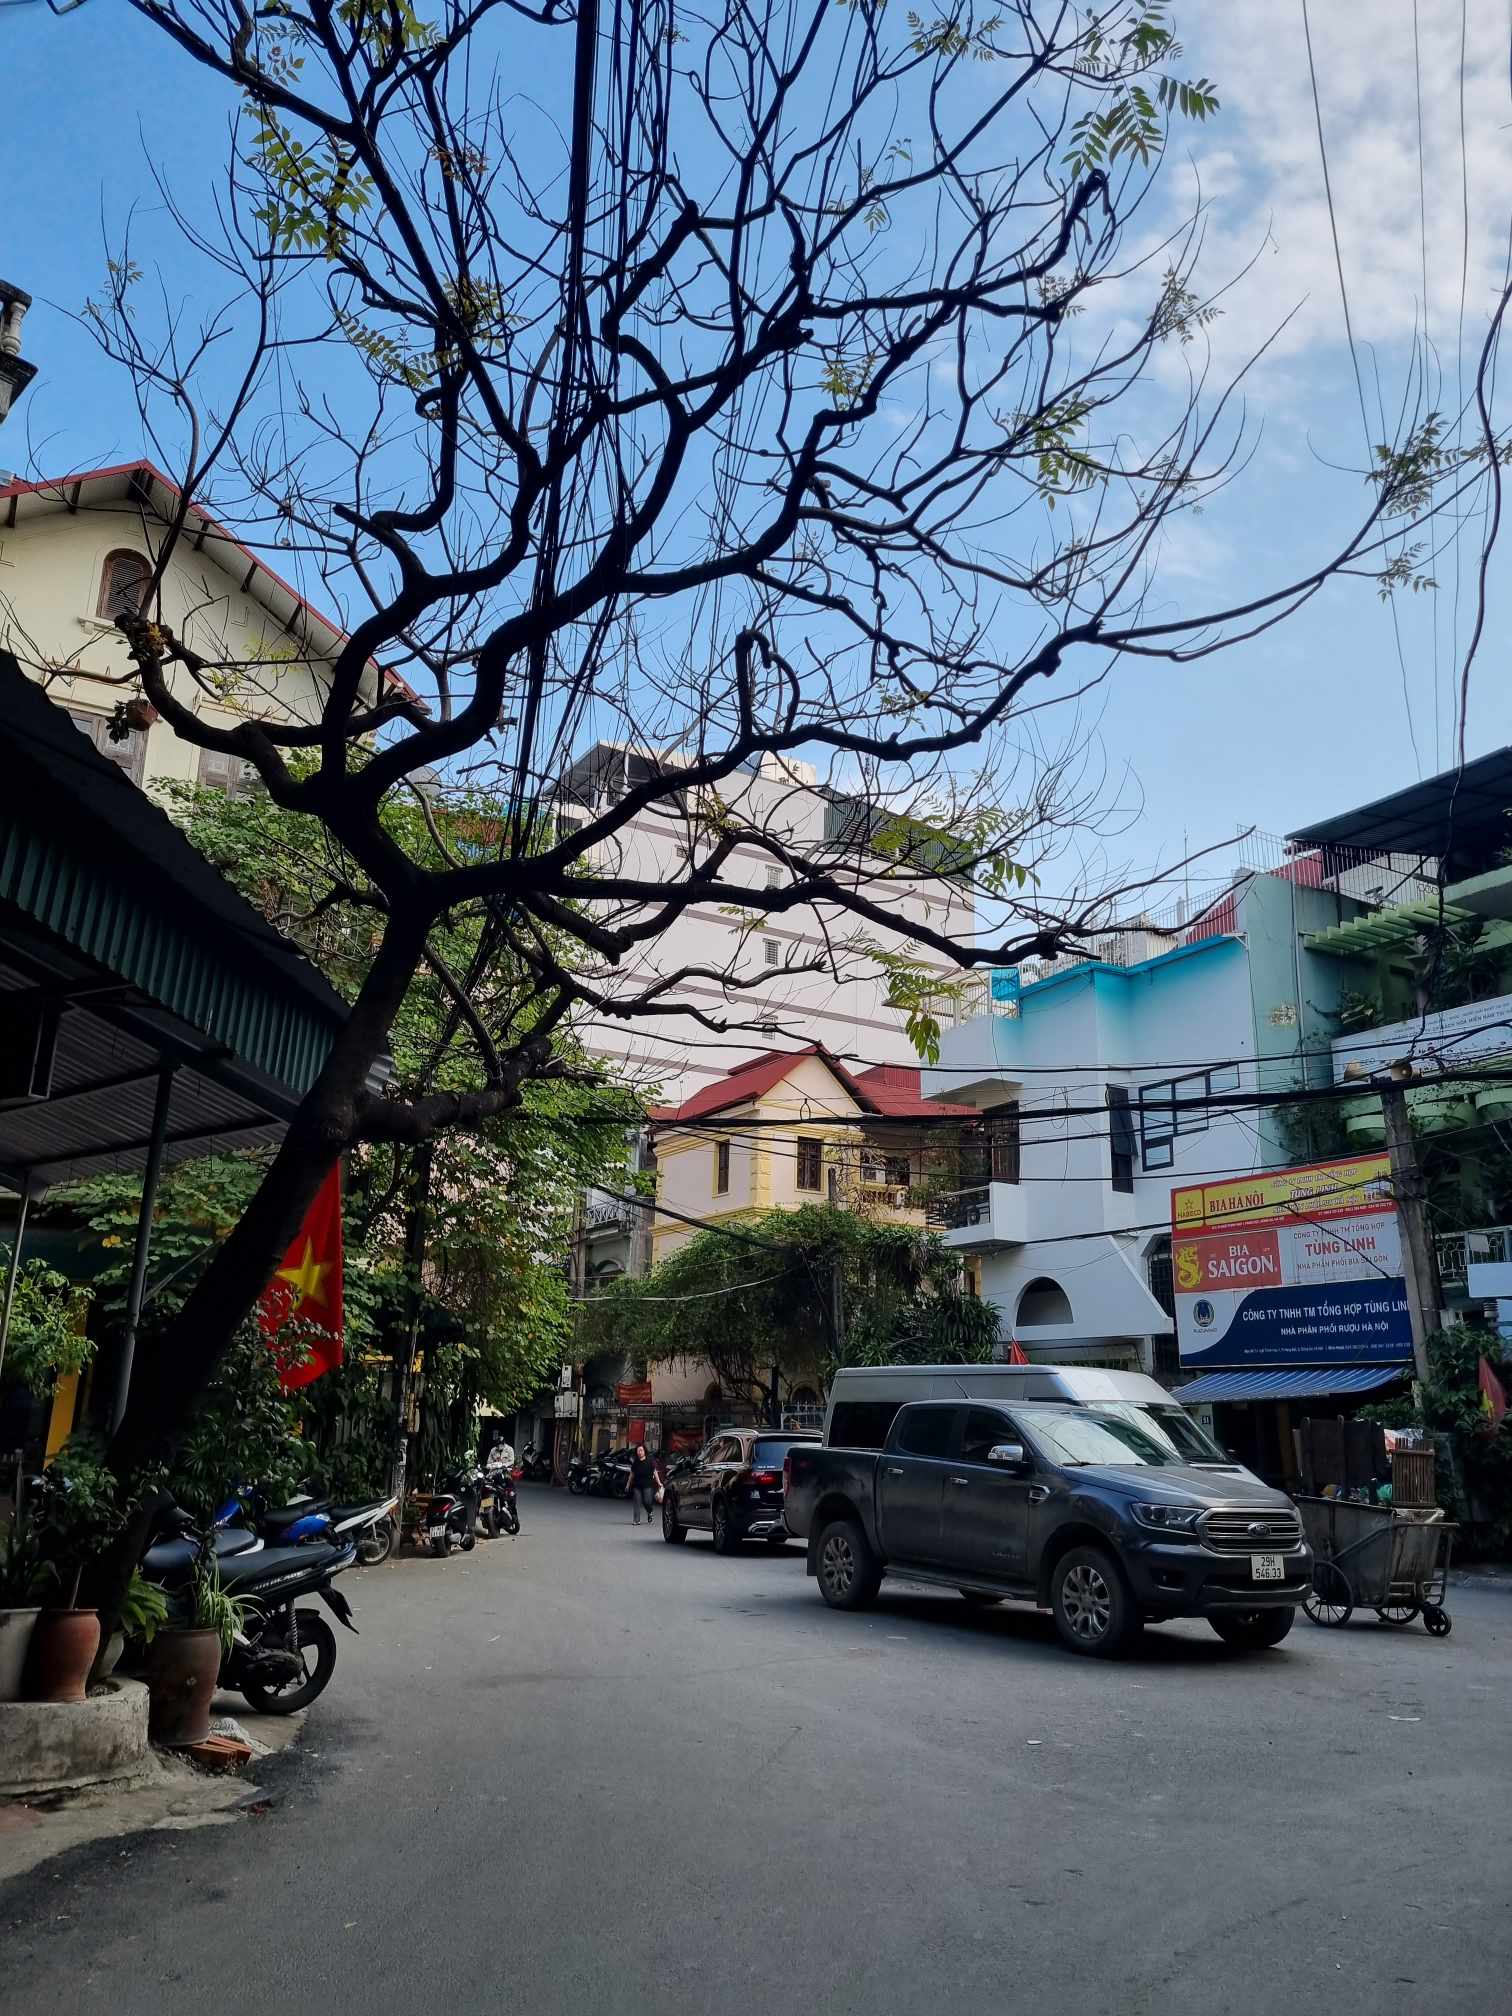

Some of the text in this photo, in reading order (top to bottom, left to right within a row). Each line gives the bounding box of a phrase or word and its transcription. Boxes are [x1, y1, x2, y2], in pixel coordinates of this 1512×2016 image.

[1209, 1198, 1228, 1212] BIA
[1228, 1244, 1249, 1257] BIA
[1304, 1236, 1376, 1257] TÙNG LINH
[1207, 1254, 1274, 1278] SAIGON
[1242, 1308, 1265, 1321] CÔNG
[1266, 1309, 1277, 1320] TY
[1279, 1307, 1302, 1319] TNHH
[1303, 1307, 1316, 1317] TM
[1317, 1300, 1342, 1316] TỔNG
[1343, 1303, 1361, 1317] HỢP
[1364, 1300, 1389, 1314] TÙNG
[1319, 1321, 1337, 1333] PHỐI
